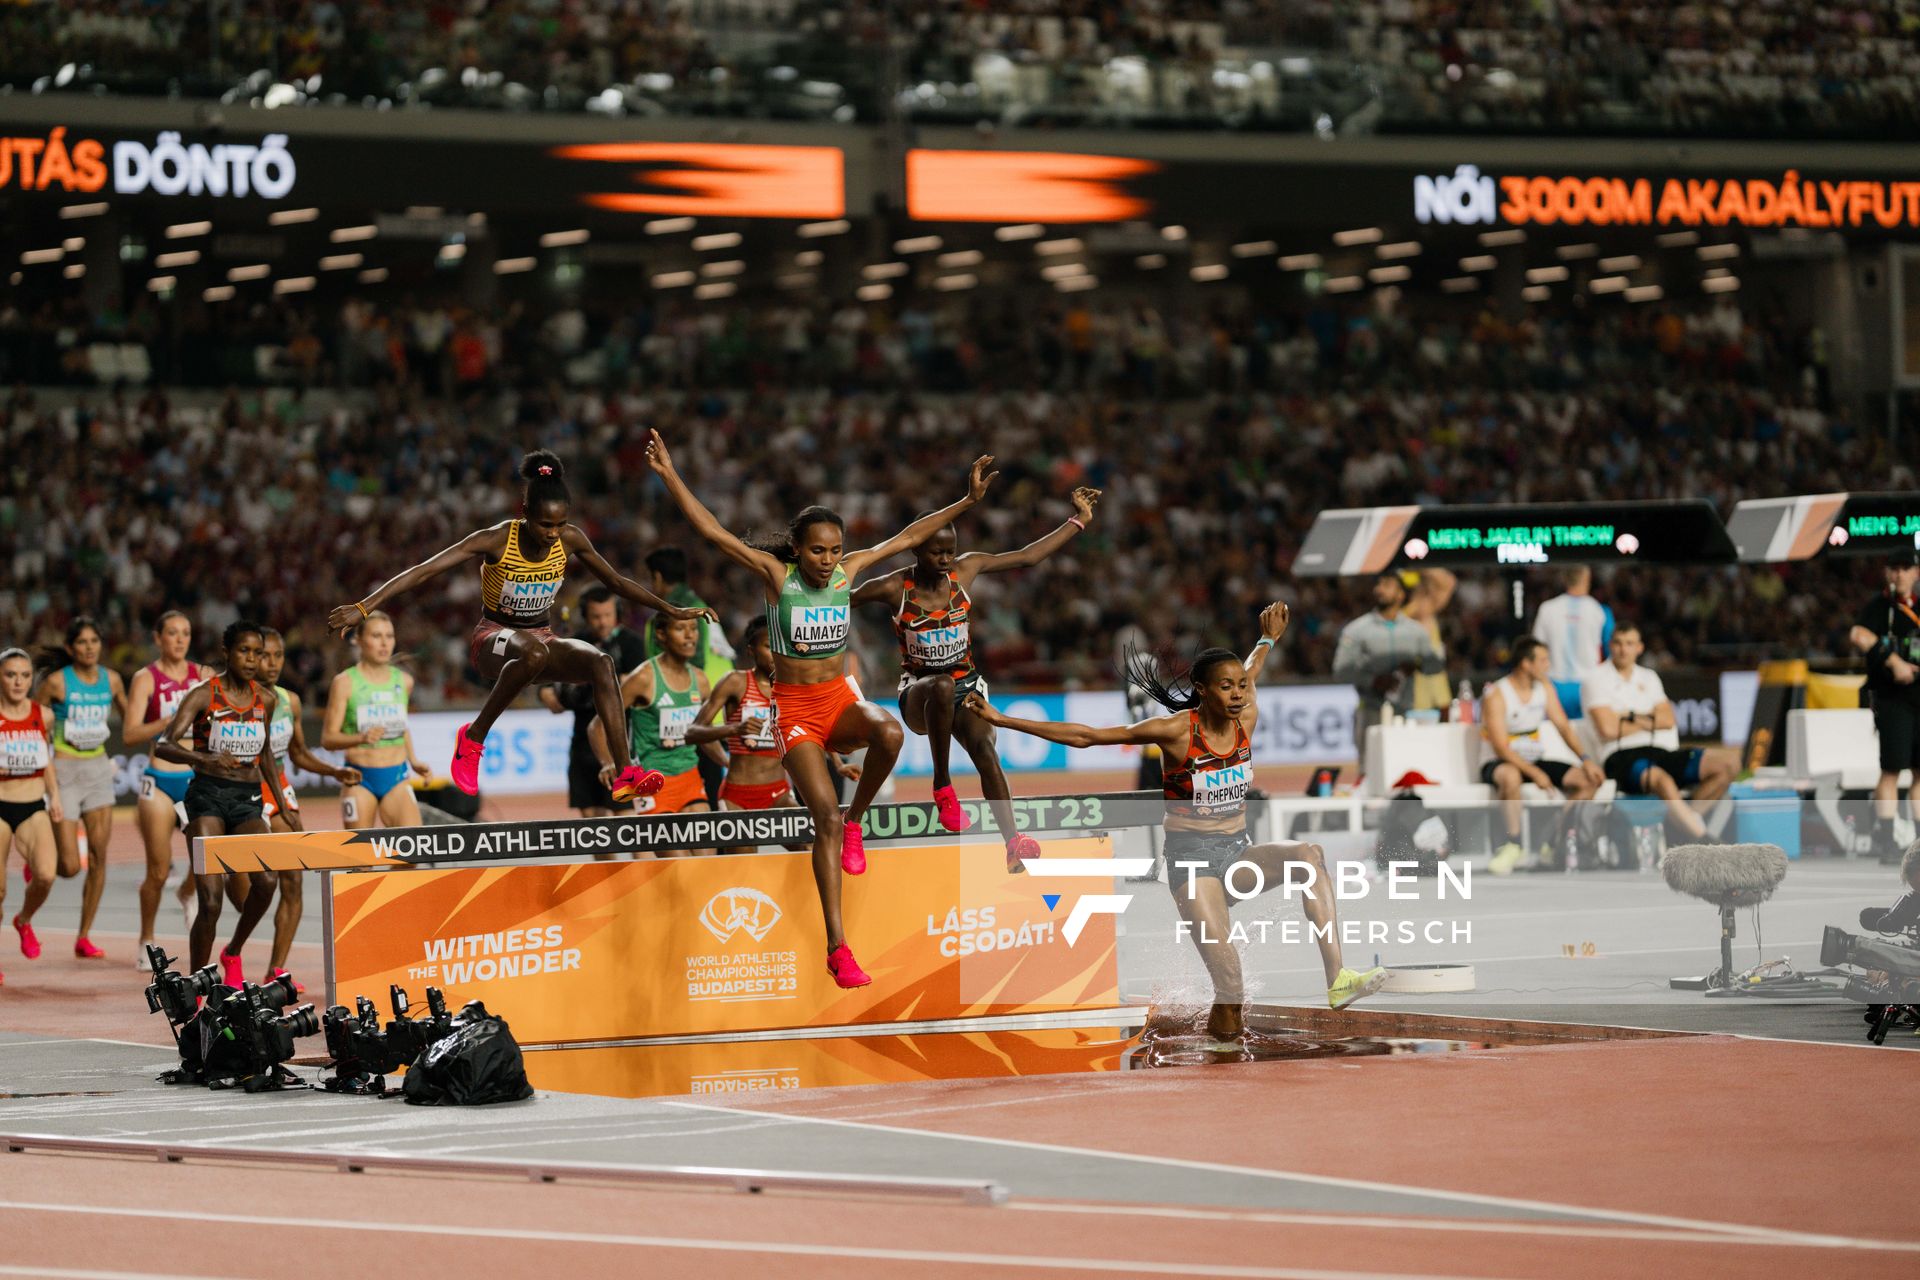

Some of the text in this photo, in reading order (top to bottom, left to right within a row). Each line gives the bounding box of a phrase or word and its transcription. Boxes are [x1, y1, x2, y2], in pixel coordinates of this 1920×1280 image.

[1500, 175, 1652, 225] 3000M
[1656, 169, 1920, 228] AKADÁLYFUT
[1901, 515, 1920, 535] JA
[1428, 529, 1482, 549] MEN'S
[1552, 525, 1615, 546] THROW
[505, 571, 560, 583] UGANDA
[514, 583, 556, 595] NTN
[804, 607, 847, 624] NTN
[916, 628, 959, 644] NTN
[909, 638, 966, 658] CHEROTICH
[68, 703, 111, 721] INDI
[671, 708, 698, 721] NTN
[221, 725, 257, 737] NTN
[6, 741, 39, 753] NTN
[1206, 765, 1245, 788] NTN
[1195, 792, 1205, 804] B.
[370, 834, 465, 859] WORLD
[474, 826, 611, 854] ATHLETICS
[617, 815, 816, 847] CHAMPIONSHIPS
[1060, 797, 1104, 828] 23
[927, 905, 996, 936] LÁSS
[424, 925, 563, 962] WITNESS
[940, 920, 1054, 957] CSODÁT!
[408, 948, 582, 986] THE WONDER
[686, 951, 797, 968] WORLD ATHLETICS
[686, 964, 798, 981] CHAMPIONSHIPS
[688, 977, 797, 996] BUDAPEST 23
